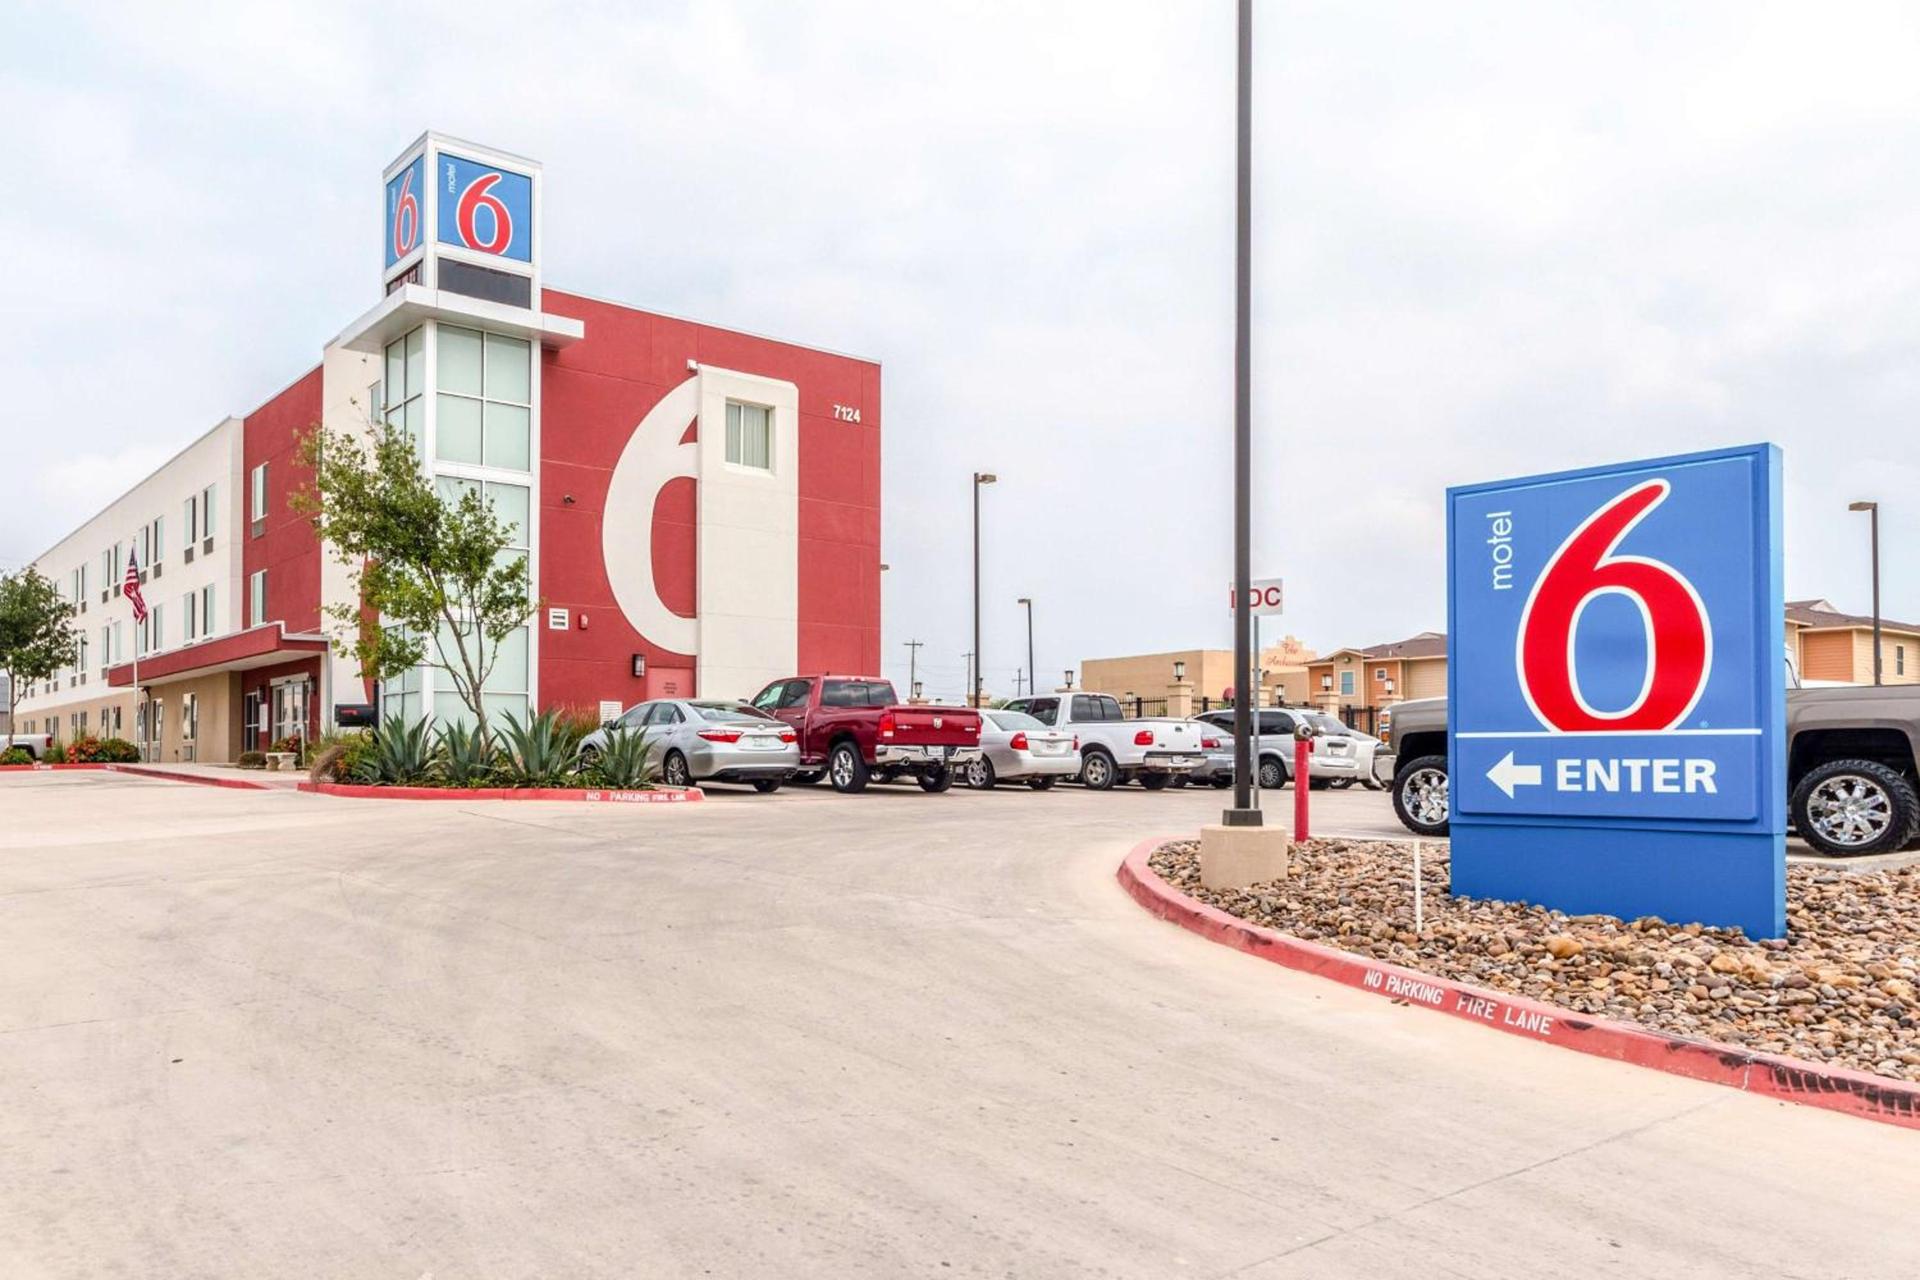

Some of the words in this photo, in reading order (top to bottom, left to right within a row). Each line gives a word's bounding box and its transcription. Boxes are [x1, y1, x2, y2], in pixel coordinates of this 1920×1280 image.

[393, 167, 419, 258] 6
[456, 172, 513, 256] 6
[833, 404, 861, 424] 7124
[1486, 510, 1513, 590] motel
[1231, 587, 1281, 609] DC
[1515, 478, 1713, 734] 6
[586, 791, 600, 801] NO
[610, 791, 650, 802] PARKING
[1556, 758, 1718, 794] ENTER
[1364, 969, 1382, 988] NO
[1386, 975, 1444, 1005] PARKING
[1456, 994, 1498, 1020] FIRE
[1504, 1007, 1554, 1035] LANE
